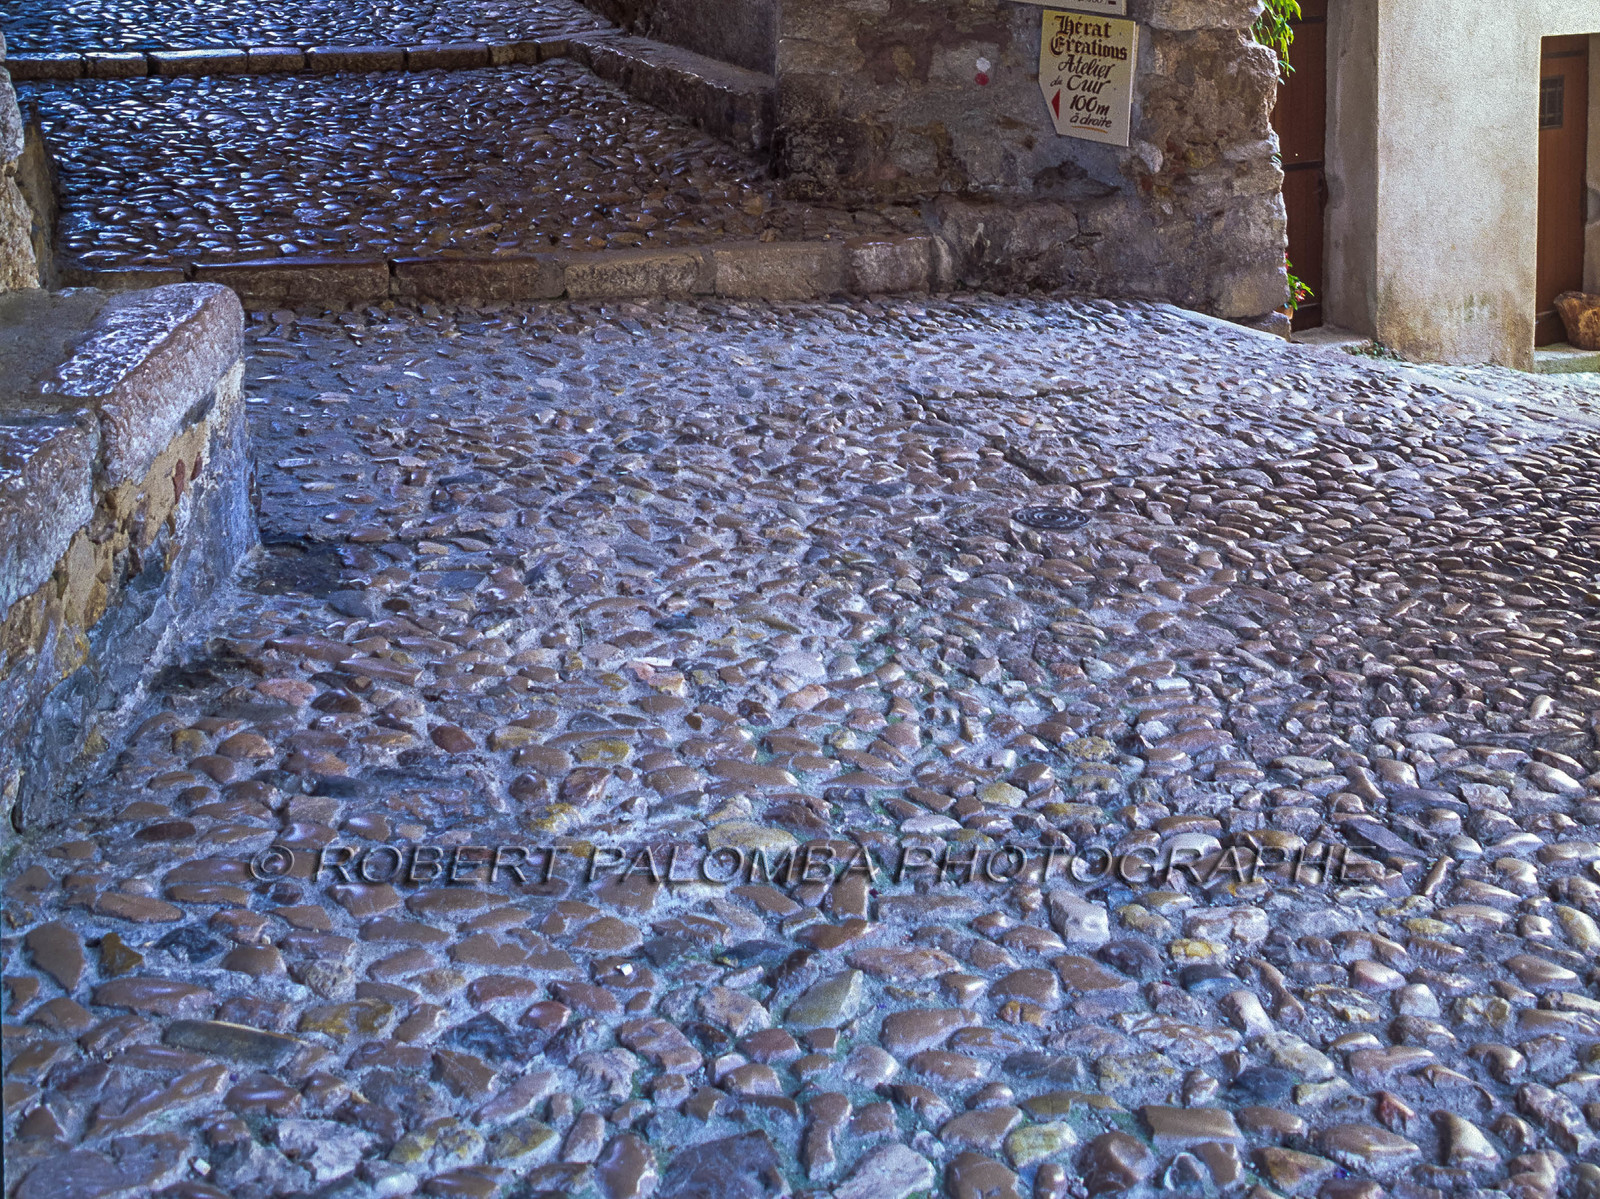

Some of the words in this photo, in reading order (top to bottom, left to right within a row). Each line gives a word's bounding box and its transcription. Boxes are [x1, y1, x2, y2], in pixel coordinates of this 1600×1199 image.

[1050, 36, 1128, 60] Créations
[1058, 54, 1115, 79] Atelier
[1080, 113, 1112, 128] droite
